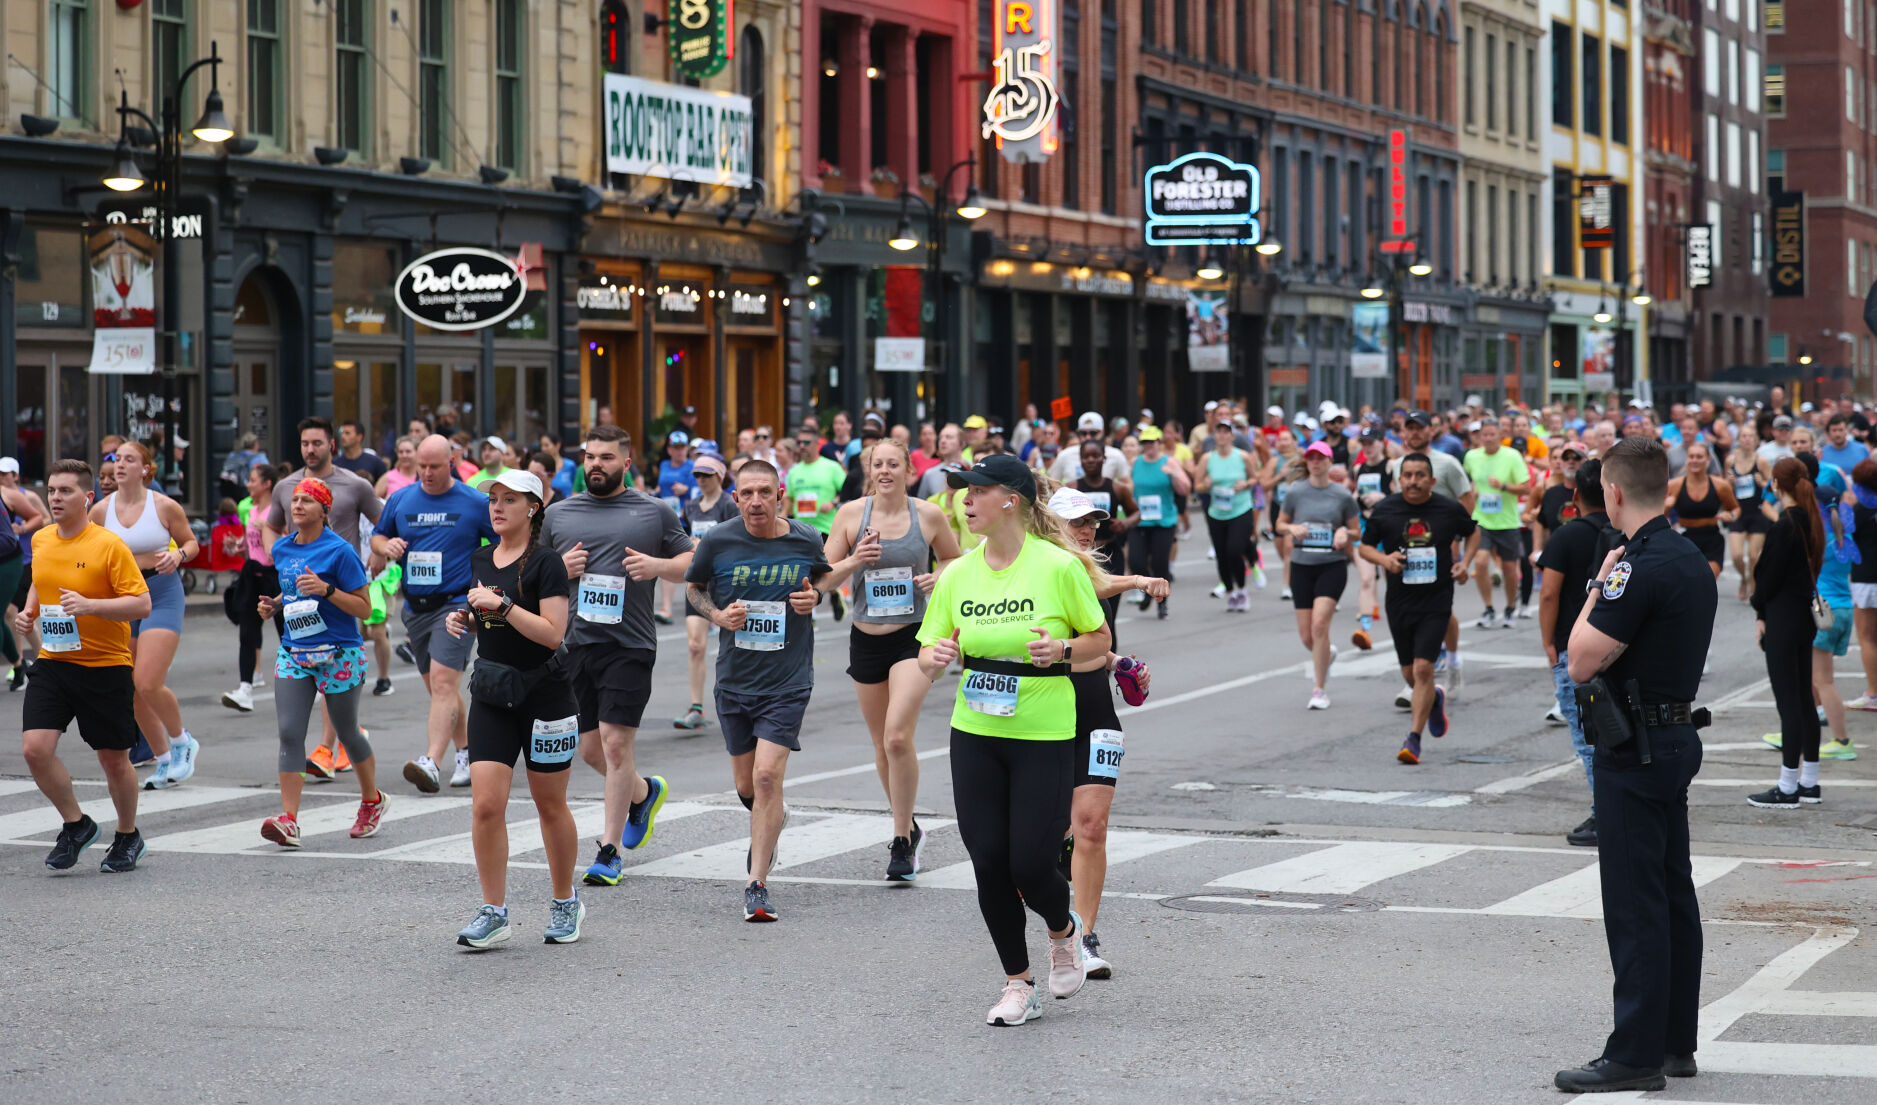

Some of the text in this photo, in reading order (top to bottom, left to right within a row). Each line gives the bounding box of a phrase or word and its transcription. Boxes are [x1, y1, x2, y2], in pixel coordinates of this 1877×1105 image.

[611, 91, 752, 174] ROOFTOP BAR OPEN
[1182, 165, 1218, 182] OLD
[1153, 180, 1248, 200] FORESTER
[1776, 204, 1801, 263] DISTIL
[1689, 227, 1710, 288] REPEAL
[43, 301, 59, 320] 129
[417, 512, 448, 523] FIGHT
[411, 566, 437, 577] 8701E
[583, 590, 619, 606] 7341D
[872, 584, 906, 597] 6801D
[960, 598, 1034, 617] Gordon
[42, 621, 74, 635] 5486D
[976, 614, 1035, 626] FOOD SERVICE
[534, 735, 576, 753] 5526D
